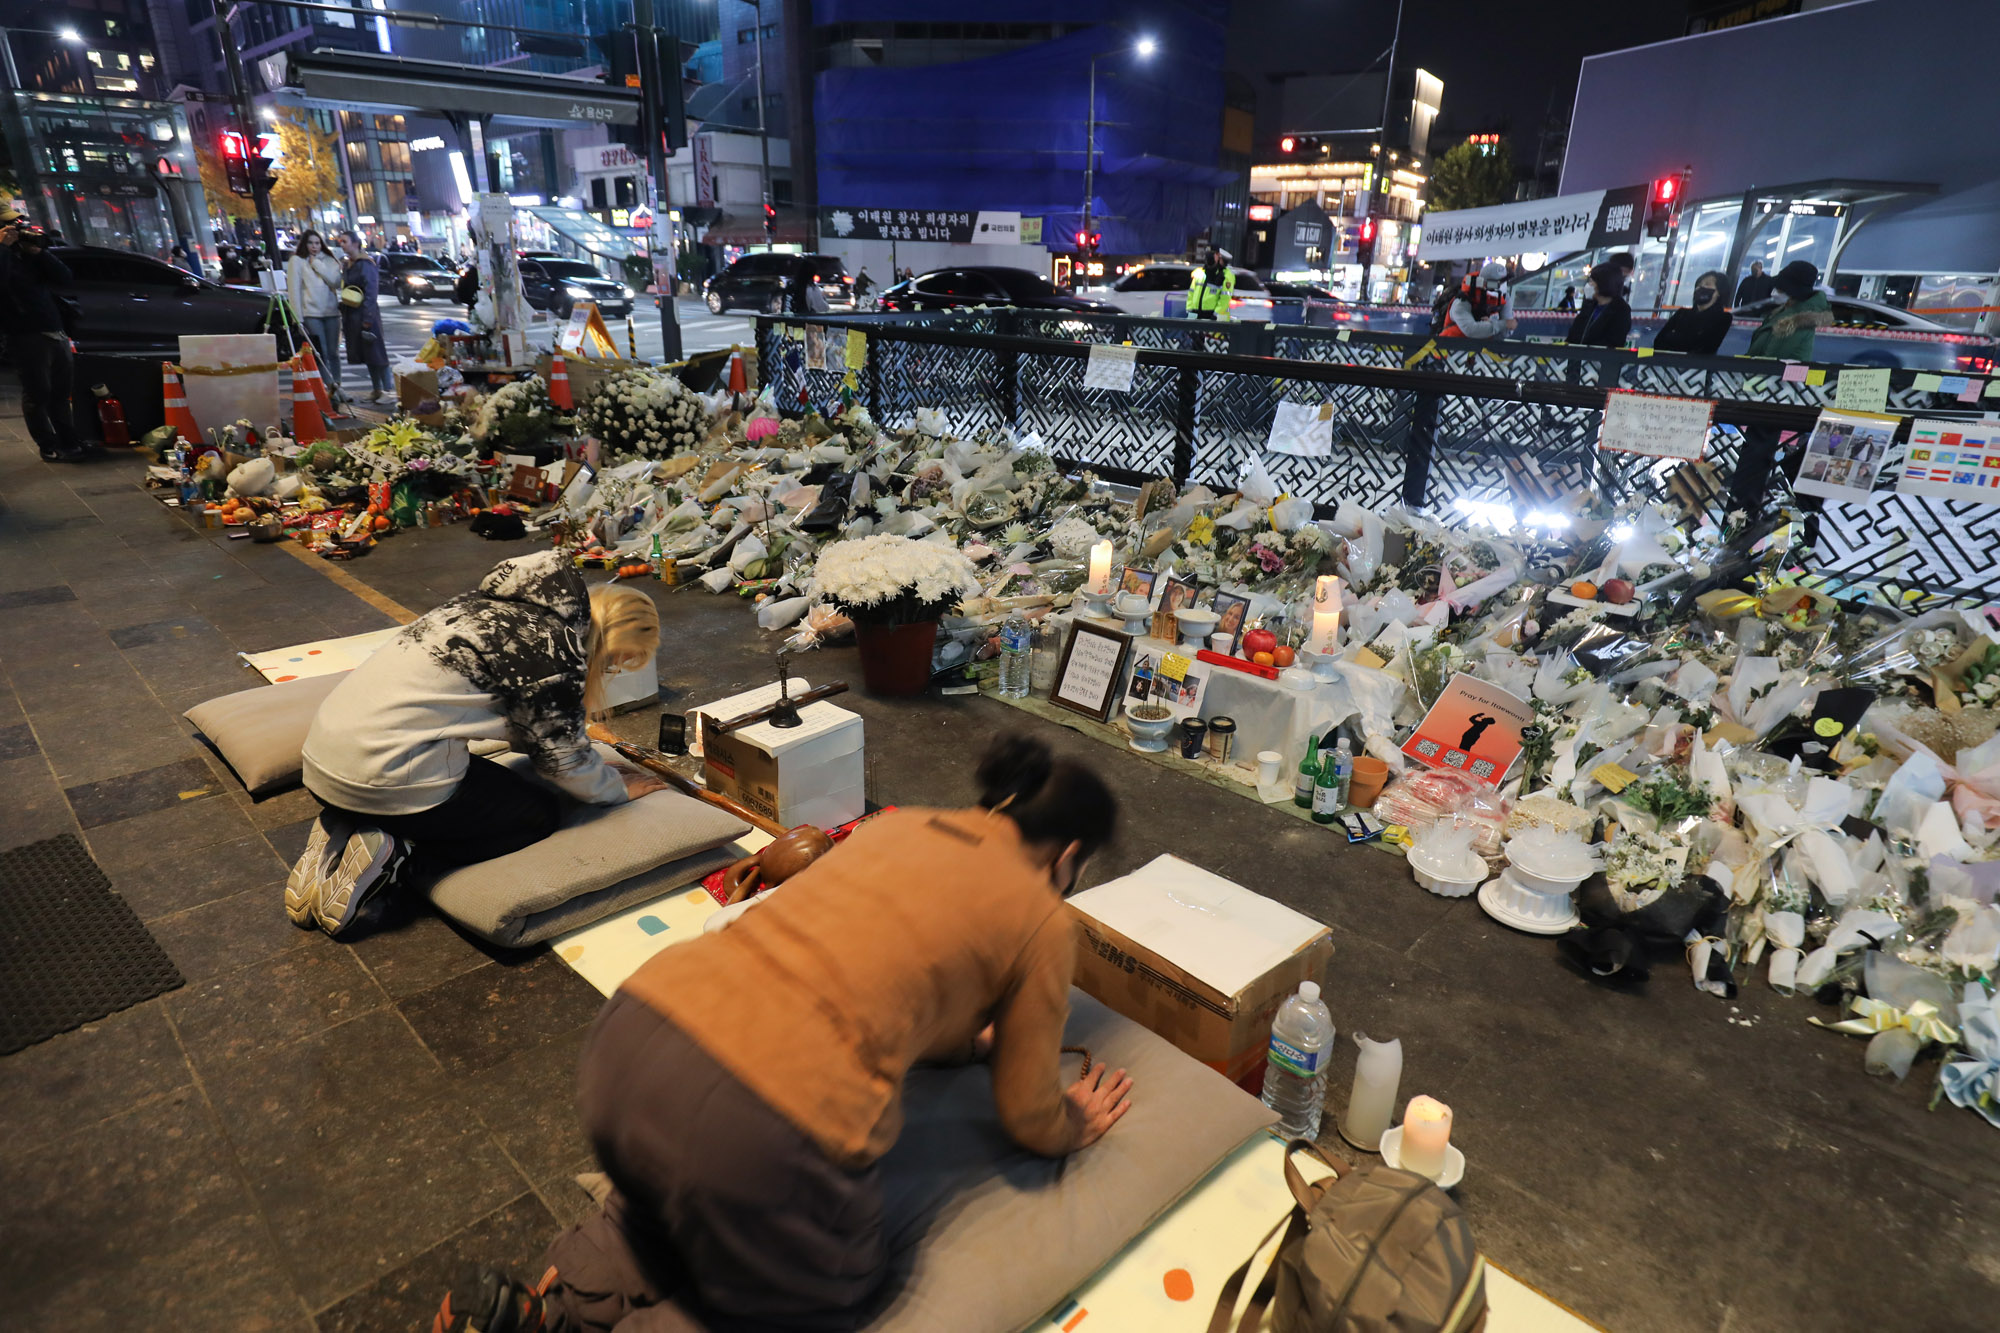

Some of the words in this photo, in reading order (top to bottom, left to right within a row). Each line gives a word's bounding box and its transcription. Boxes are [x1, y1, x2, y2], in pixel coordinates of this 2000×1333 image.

[586, 106, 613, 120] 용산구
[858, 209, 893, 224] 이태원
[898, 212, 921, 226] 참사
[926, 212, 969, 227] 희생자의
[1608, 203, 1634, 218] 더불어
[991, 224, 1016, 233] 국민의힘
[1426, 229, 1453, 246] 이태원
[1454, 226, 1473, 244] 참사
[1474, 221, 1515, 241] 희생자의
[1517, 216, 1552, 239] 명복을
[1553, 212, 1591, 235] 빕니다
[1606, 217, 1633, 233] 민주당
[878, 226, 913, 239] 명복을
[918, 226, 952, 241] 빕니다
[1460, 690, 1477, 700] Pray
[1479, 696, 1489, 705] for
[1098, 939, 1138, 975] EMS
